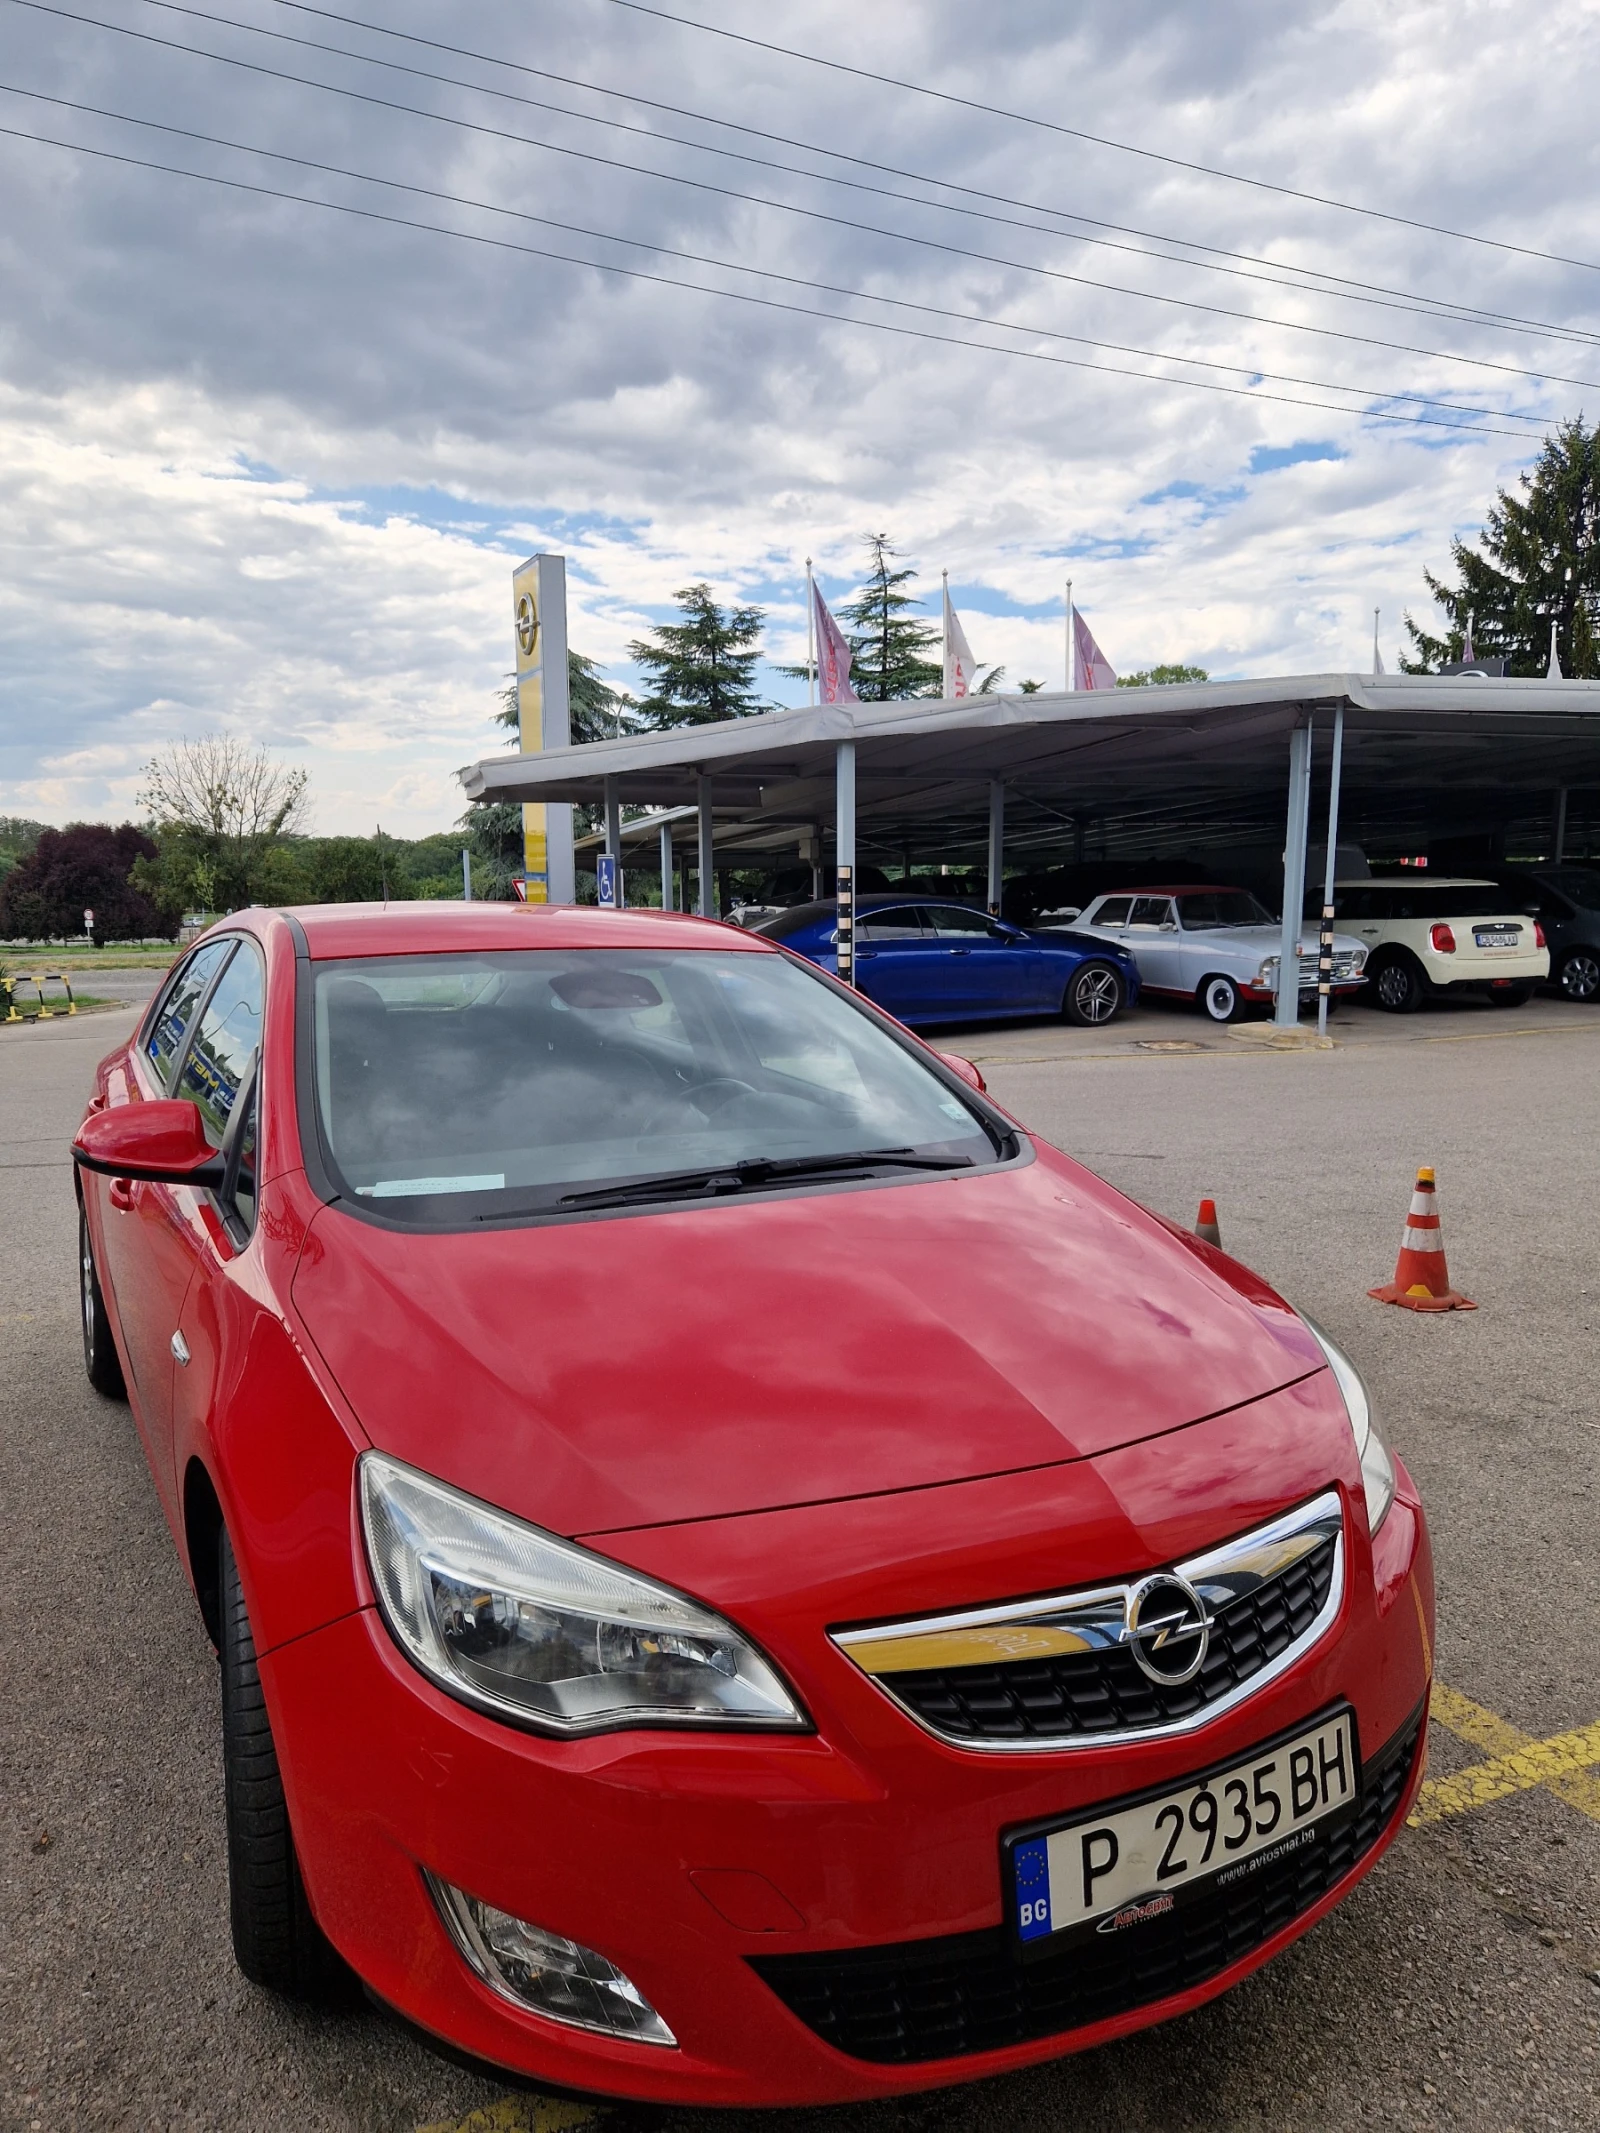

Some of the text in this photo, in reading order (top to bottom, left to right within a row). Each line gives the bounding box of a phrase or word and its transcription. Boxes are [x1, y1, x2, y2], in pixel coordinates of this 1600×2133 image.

[1081, 1728, 1347, 1907] P 2935 BH
[1216, 1827, 1316, 1887] www.avtosviat.bg
[1020, 1898, 1047, 1926] BG
